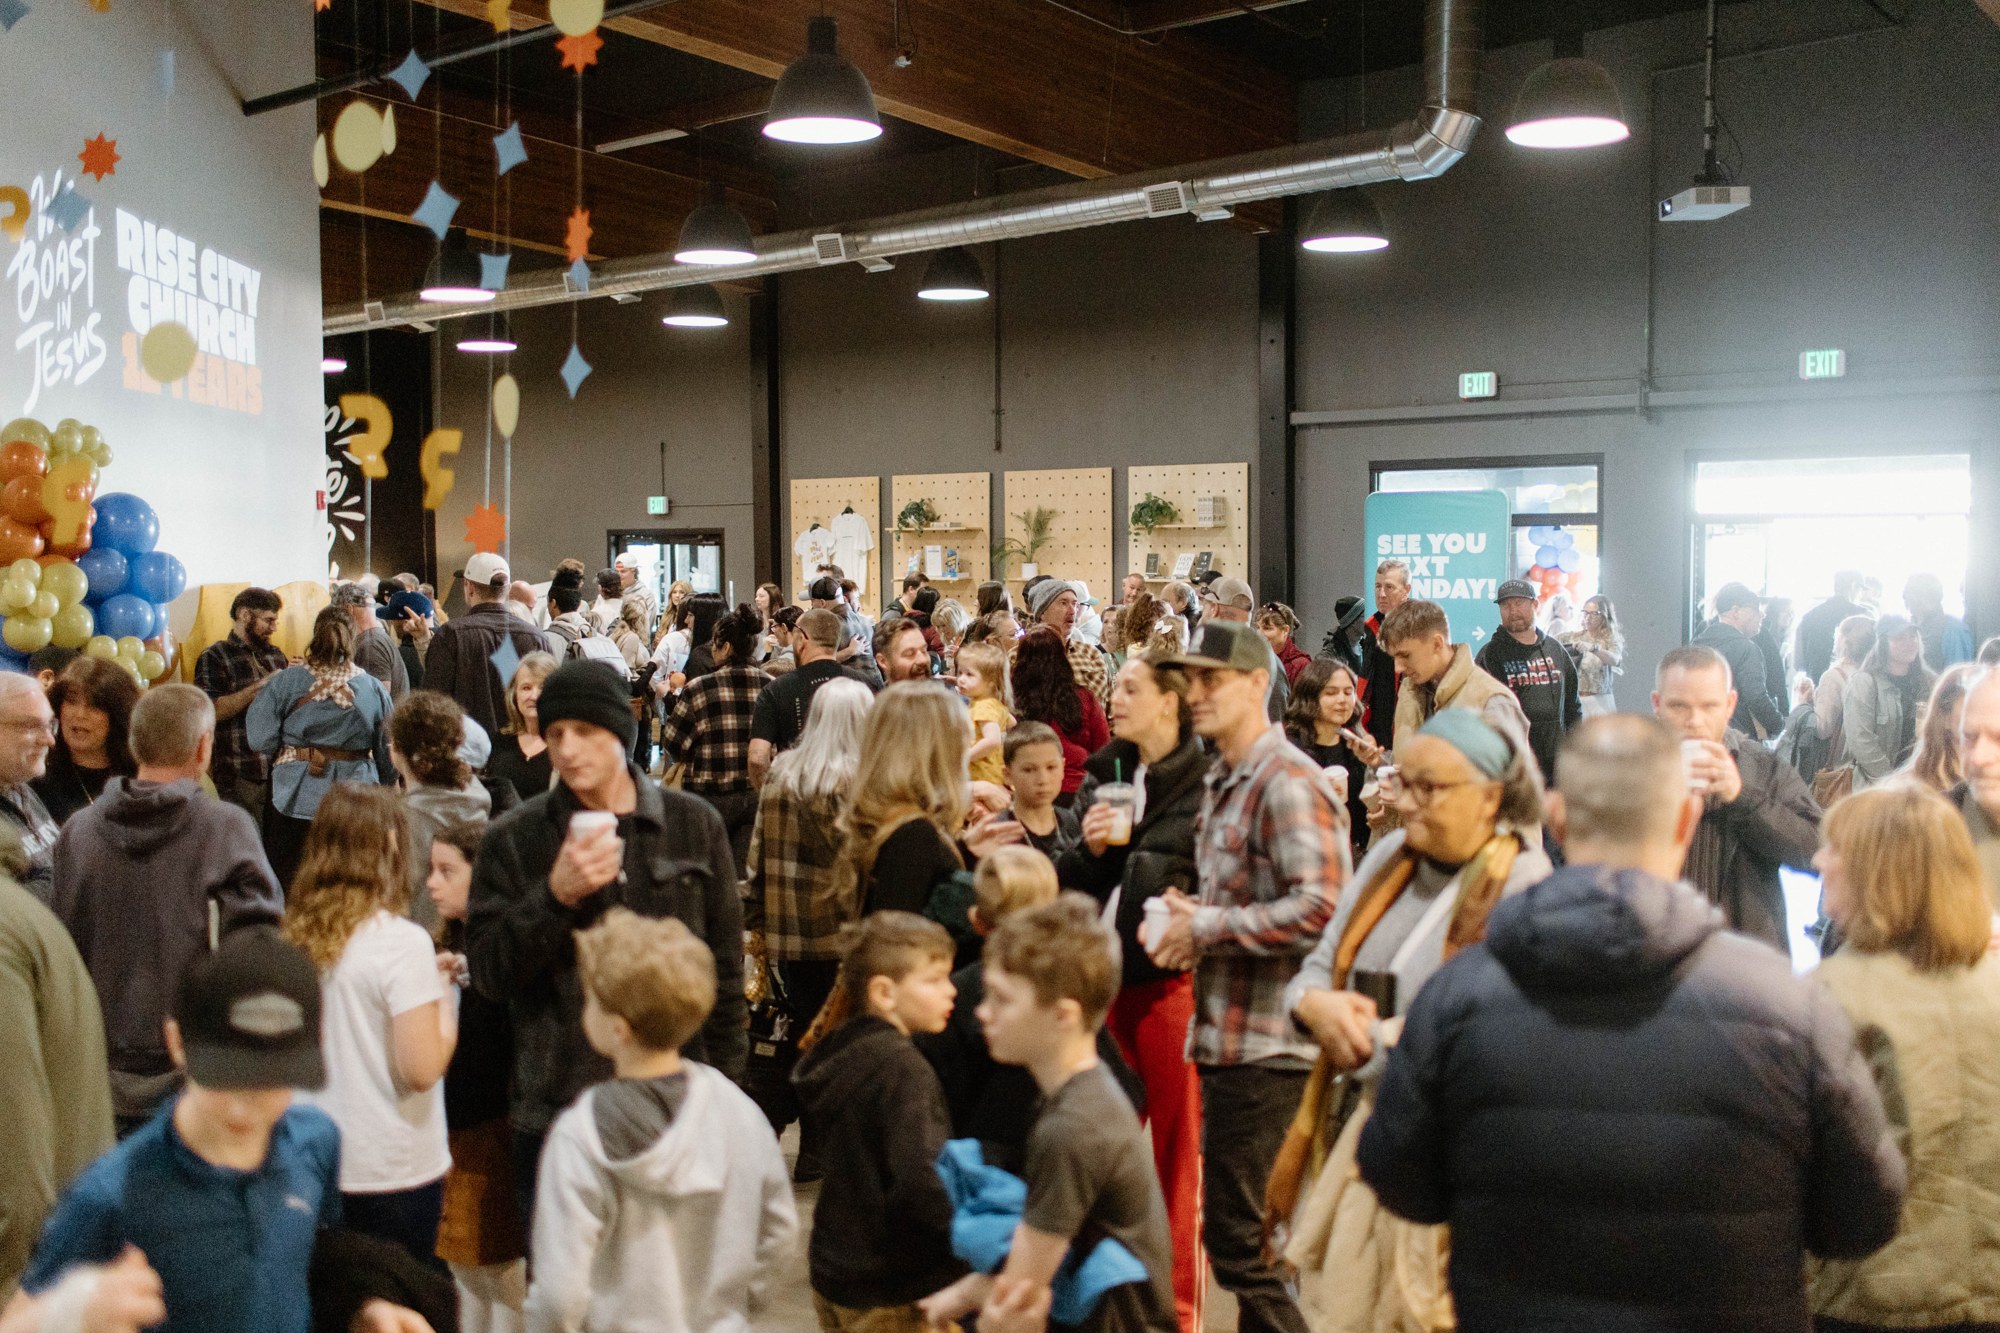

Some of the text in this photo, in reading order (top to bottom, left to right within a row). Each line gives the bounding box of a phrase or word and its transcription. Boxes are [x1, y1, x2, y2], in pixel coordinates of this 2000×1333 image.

[116, 207, 261, 318] RISE CITY
[56, 293, 72, 332] IN
[127, 274, 257, 366] CHURCH
[122, 331, 264, 416] 1 EARS
[1806, 350, 1840, 377] EXIT
[1464, 372, 1491, 396] EXIT
[1377, 532, 1487, 554] SEE YOU
[1377, 555, 1450, 577] XT
[1406, 578, 1497, 600] NDAY!
